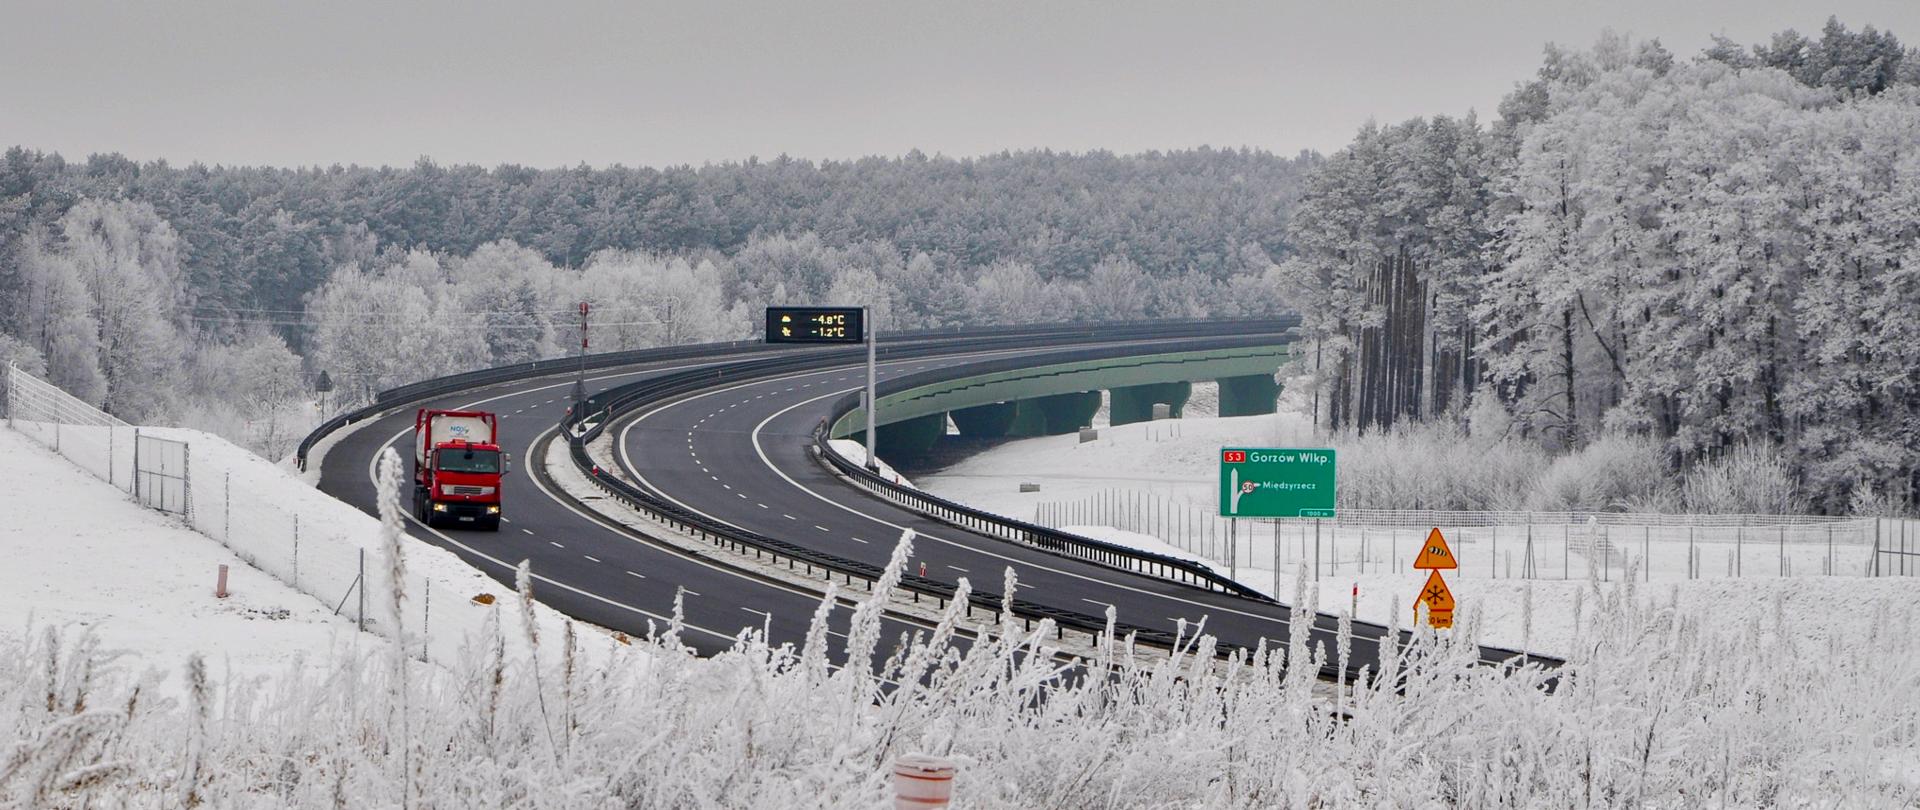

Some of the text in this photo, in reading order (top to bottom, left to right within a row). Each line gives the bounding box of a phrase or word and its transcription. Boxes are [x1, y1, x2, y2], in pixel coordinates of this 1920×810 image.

[1250, 452, 1332, 465] Gorzów Wlkp.
[1263, 481, 1316, 491] Międzyrzecz
